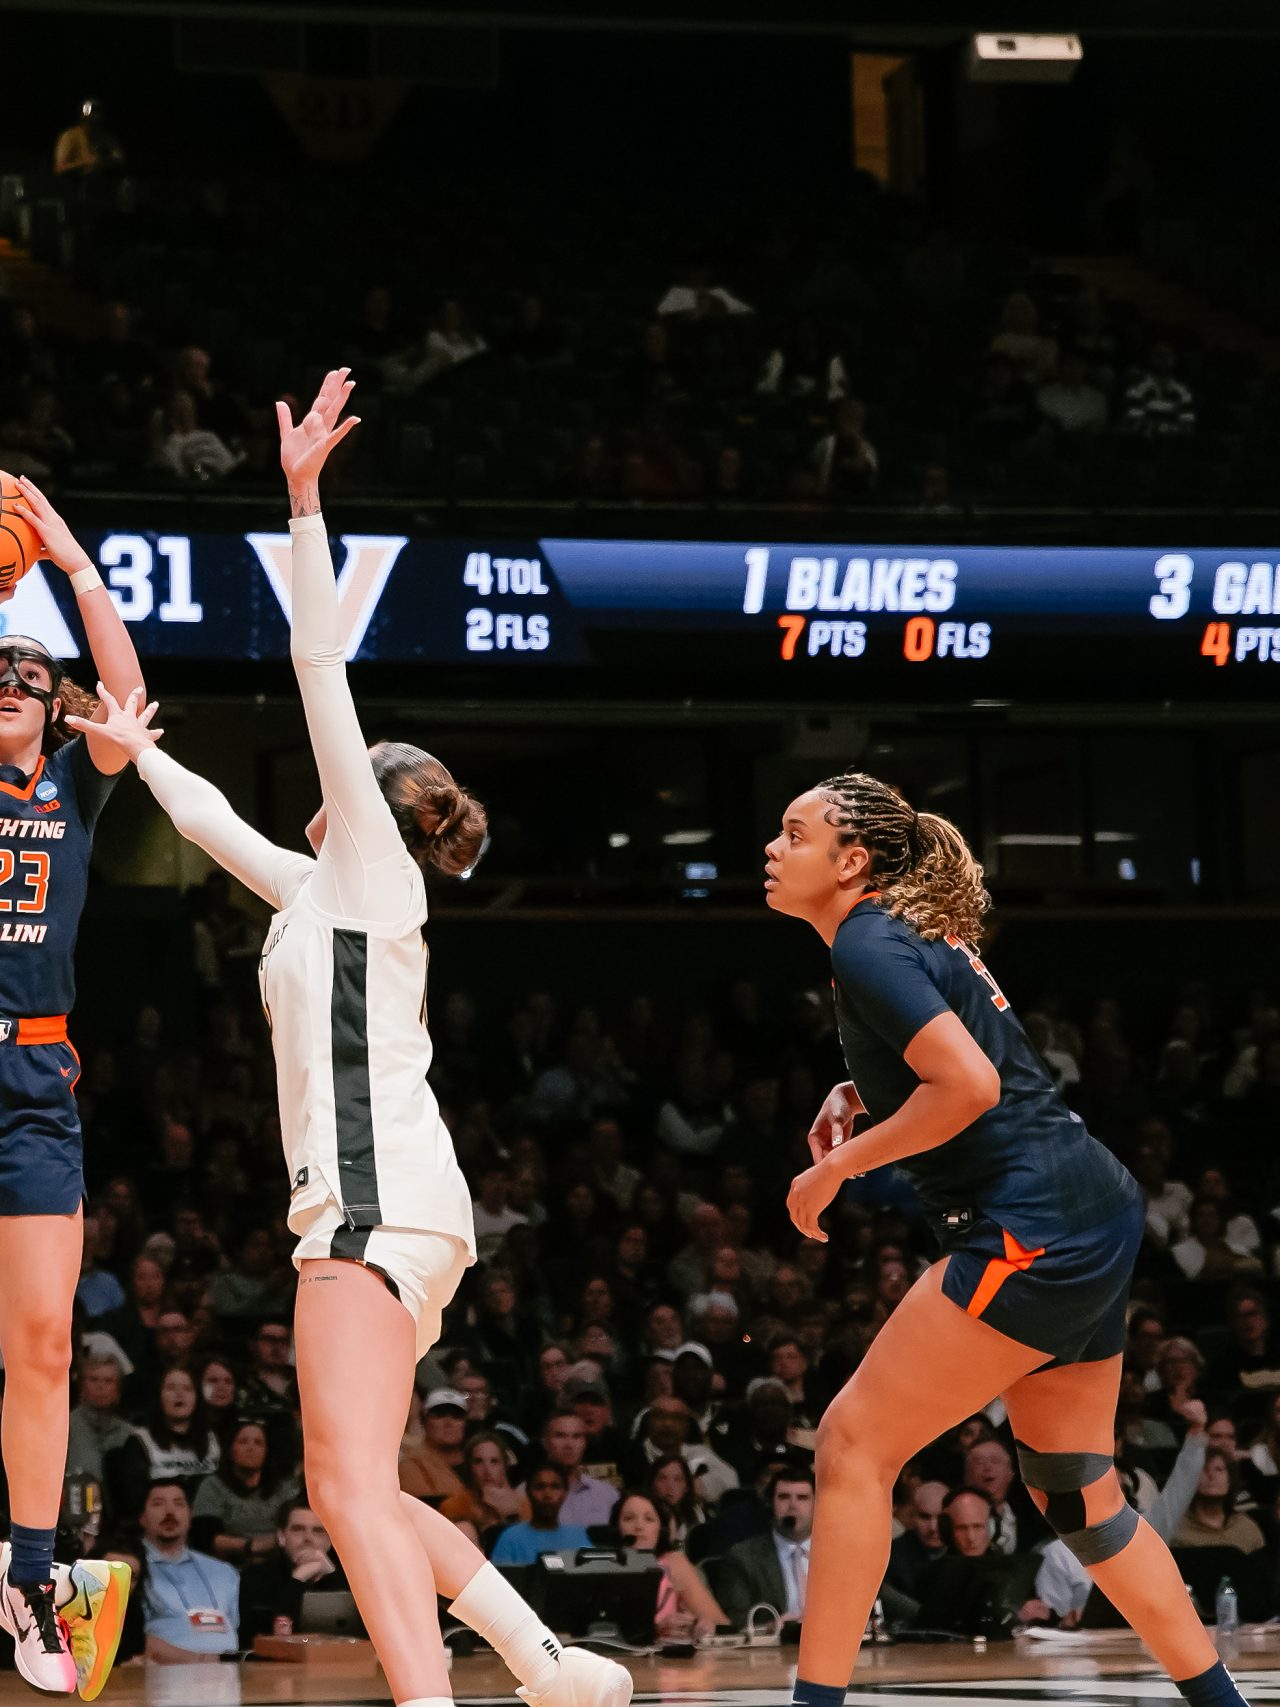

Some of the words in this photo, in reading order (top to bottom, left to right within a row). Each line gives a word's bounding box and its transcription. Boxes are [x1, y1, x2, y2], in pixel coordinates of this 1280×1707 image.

[99, 534, 203, 622] 31
[743, 548, 769, 614] 1
[785, 557, 959, 613] BLAKES
[1150, 553, 1195, 619] 3
[466, 608, 493, 651] 2
[496, 614, 549, 650] FLS
[777, 615, 806, 660] 7
[808, 621, 867, 657] PTS
[904, 616, 935, 661] 0
[937, 622, 991, 658] FLS
[1200, 622, 1231, 666] 4
